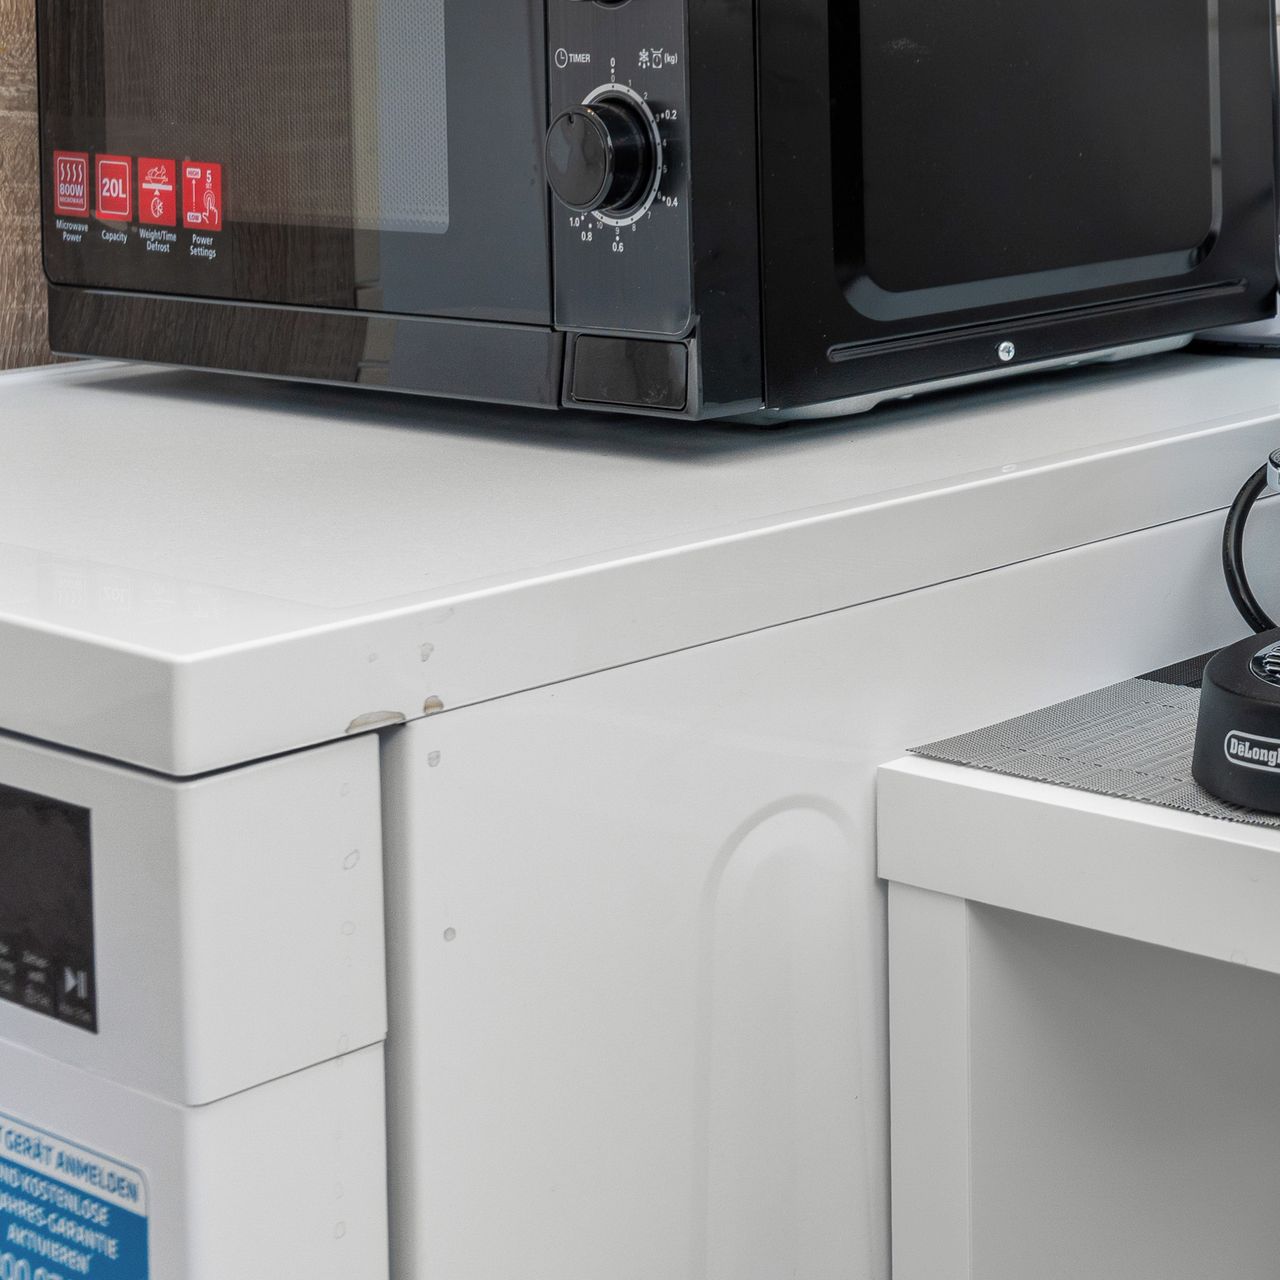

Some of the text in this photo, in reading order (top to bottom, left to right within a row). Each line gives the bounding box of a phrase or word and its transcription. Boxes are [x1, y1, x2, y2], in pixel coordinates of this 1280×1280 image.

[568, 53, 591, 64] TIMER
[664, 52, 678, 64] (kg)
[665, 109, 678, 120] 0.2
[206, 170, 212, 183] 5
[59, 183, 84, 197] 800W
[102, 177, 127, 198] 20L
[666, 197, 679, 207] 0.4
[56, 219, 89, 233] Microwave
[569, 216, 581, 227] 1.0
[62, 231, 83, 243] Power
[101, 229, 128, 245] Capacity
[139, 228, 177, 242] Weight/Time
[192, 233, 214, 246] Power
[581, 231, 593, 241] 0.8
[146, 240, 171, 253] Defrost
[190, 245, 217, 260] Settings
[612, 241, 624, 253] 0.6
[55, 1150, 139, 1203] ANMELDEN
[21, 1173, 109, 1227] KOSTENLOSE
